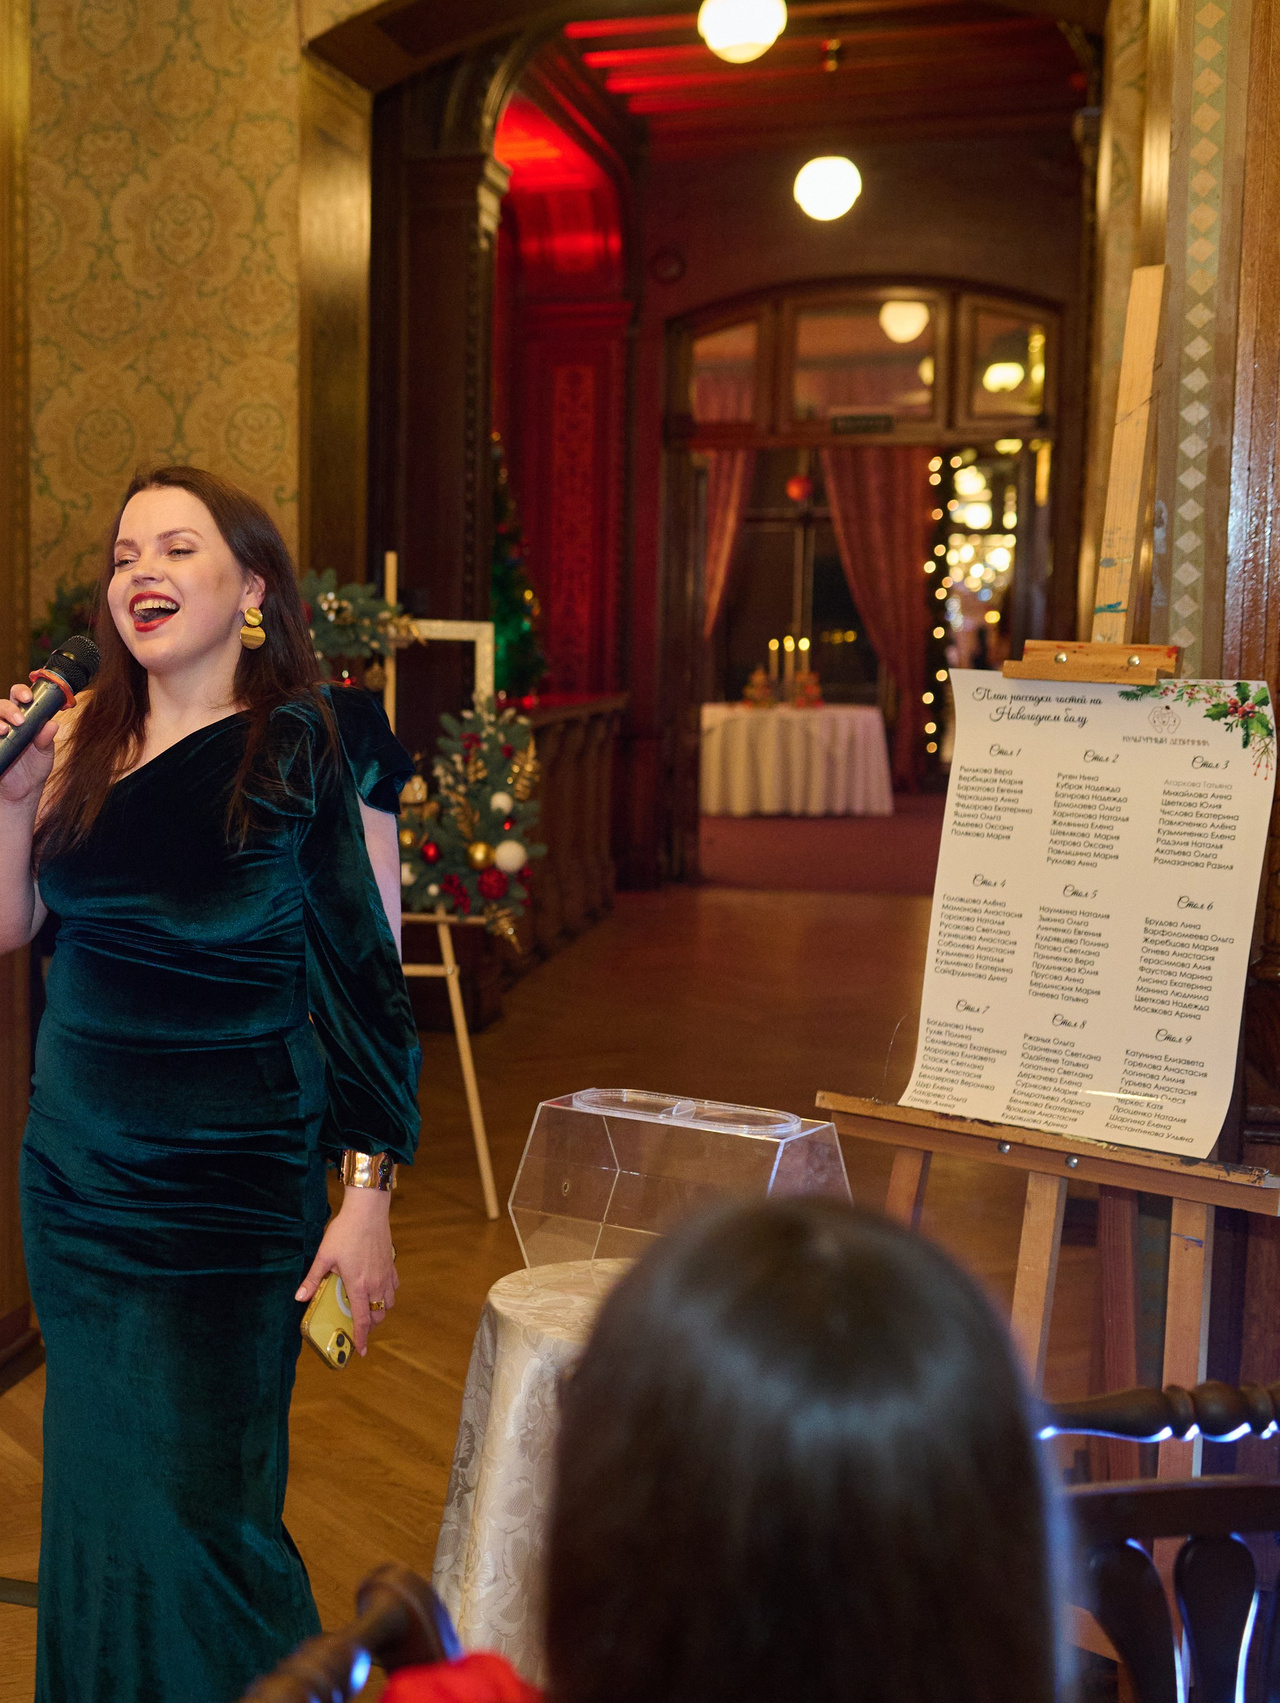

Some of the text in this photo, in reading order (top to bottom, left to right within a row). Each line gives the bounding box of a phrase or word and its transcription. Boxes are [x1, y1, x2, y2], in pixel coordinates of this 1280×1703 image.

[972, 687, 1102, 707] План рассадки гостей на
[990, 706, 1088, 727] Новогоднем балу
[989, 744, 1021, 757] Стол 1
[1083, 749, 1119, 763] Стол 2
[1192, 756, 1229, 769] Стол 3
[1085, 784, 1121, 793] Надежда
[1203, 781, 1232, 790] Татьяна
[1091, 794, 1128, 803] Надежда
[1210, 792, 1232, 800] Анна
[1098, 804, 1122, 812] Ольга
[1199, 801, 1222, 809] Юлия
[1098, 813, 1129, 822] Наталья
[1195, 811, 1239, 821] Екатерина
[1091, 822, 1114, 830] Елена
[1210, 822, 1237, 830] Алёна
[1094, 832, 1120, 841] Мария
[1211, 832, 1236, 840] Елена
[1083, 841, 1114, 850] Оксана
[1191, 840, 1223, 849] Наталья
[1093, 851, 1119, 860] Мария
[1194, 851, 1218, 859] Ольга
[1077, 859, 1098, 867] Анна
[1206, 861, 1234, 870] Разиля
[973, 874, 1006, 887] Стол 4
[1063, 884, 1098, 899] Стол 5
[1177, 895, 1214, 910] Стол 6
[1079, 909, 1110, 919] Наталия
[1066, 918, 1089, 926] Ольга
[1180, 921, 1201, 929] Лина
[1073, 928, 1101, 937] Евгения
[1080, 939, 1109, 948] Полина
[1210, 934, 1235, 943] Ольга
[1063, 946, 1100, 957] Светлана
[1192, 942, 1219, 952] Мария
[1172, 950, 1215, 961] Анастасия
[1075, 957, 1095, 967] Вера
[1192, 962, 1212, 970] Алия
[1078, 967, 1099, 975] Юлия
[1179, 970, 1213, 981] Марина
[1064, 974, 1084, 983] Анна
[1170, 979, 1212, 991] Екатерина
[1075, 986, 1101, 995] Мария
[1170, 989, 1209, 1001] Людмила
[1061, 994, 1089, 1003] Татьяна
[956, 1000, 990, 1014] Стол 7
[1172, 999, 1209, 1011] Надежда
[1174, 1010, 1201, 1019] Арина
[1052, 1014, 1087, 1029] Стол 8
[1155, 1028, 1192, 1044] Стол 9
[1053, 1038, 1075, 1047] Ольга
[1065, 1050, 1101, 1061] Светлана
[1061, 1059, 1089, 1069] Татьяна
[1164, 1055, 1205, 1067] Елизавета
[1057, 1068, 1094, 1079] Светлана
[1164, 1065, 1207, 1078] Анастасия
[1059, 1078, 1082, 1087] Елена
[1161, 1074, 1185, 1084] Лилия
[1053, 1086, 1079, 1095] Мария
[1154, 1083, 1198, 1096] Анастасия
[1061, 1096, 1091, 1107] Лариса
[1146, 1101, 1163, 1110] Катя
[1044, 1103, 1084, 1115] Екатерина
[1037, 1109, 1078, 1122] Анастасия
[1154, 1112, 1187, 1123] Наталия
[1043, 1119, 1068, 1128] Арина
[1147, 1120, 1171, 1130] Елена
[1166, 1132, 1194, 1143] Ульяна
